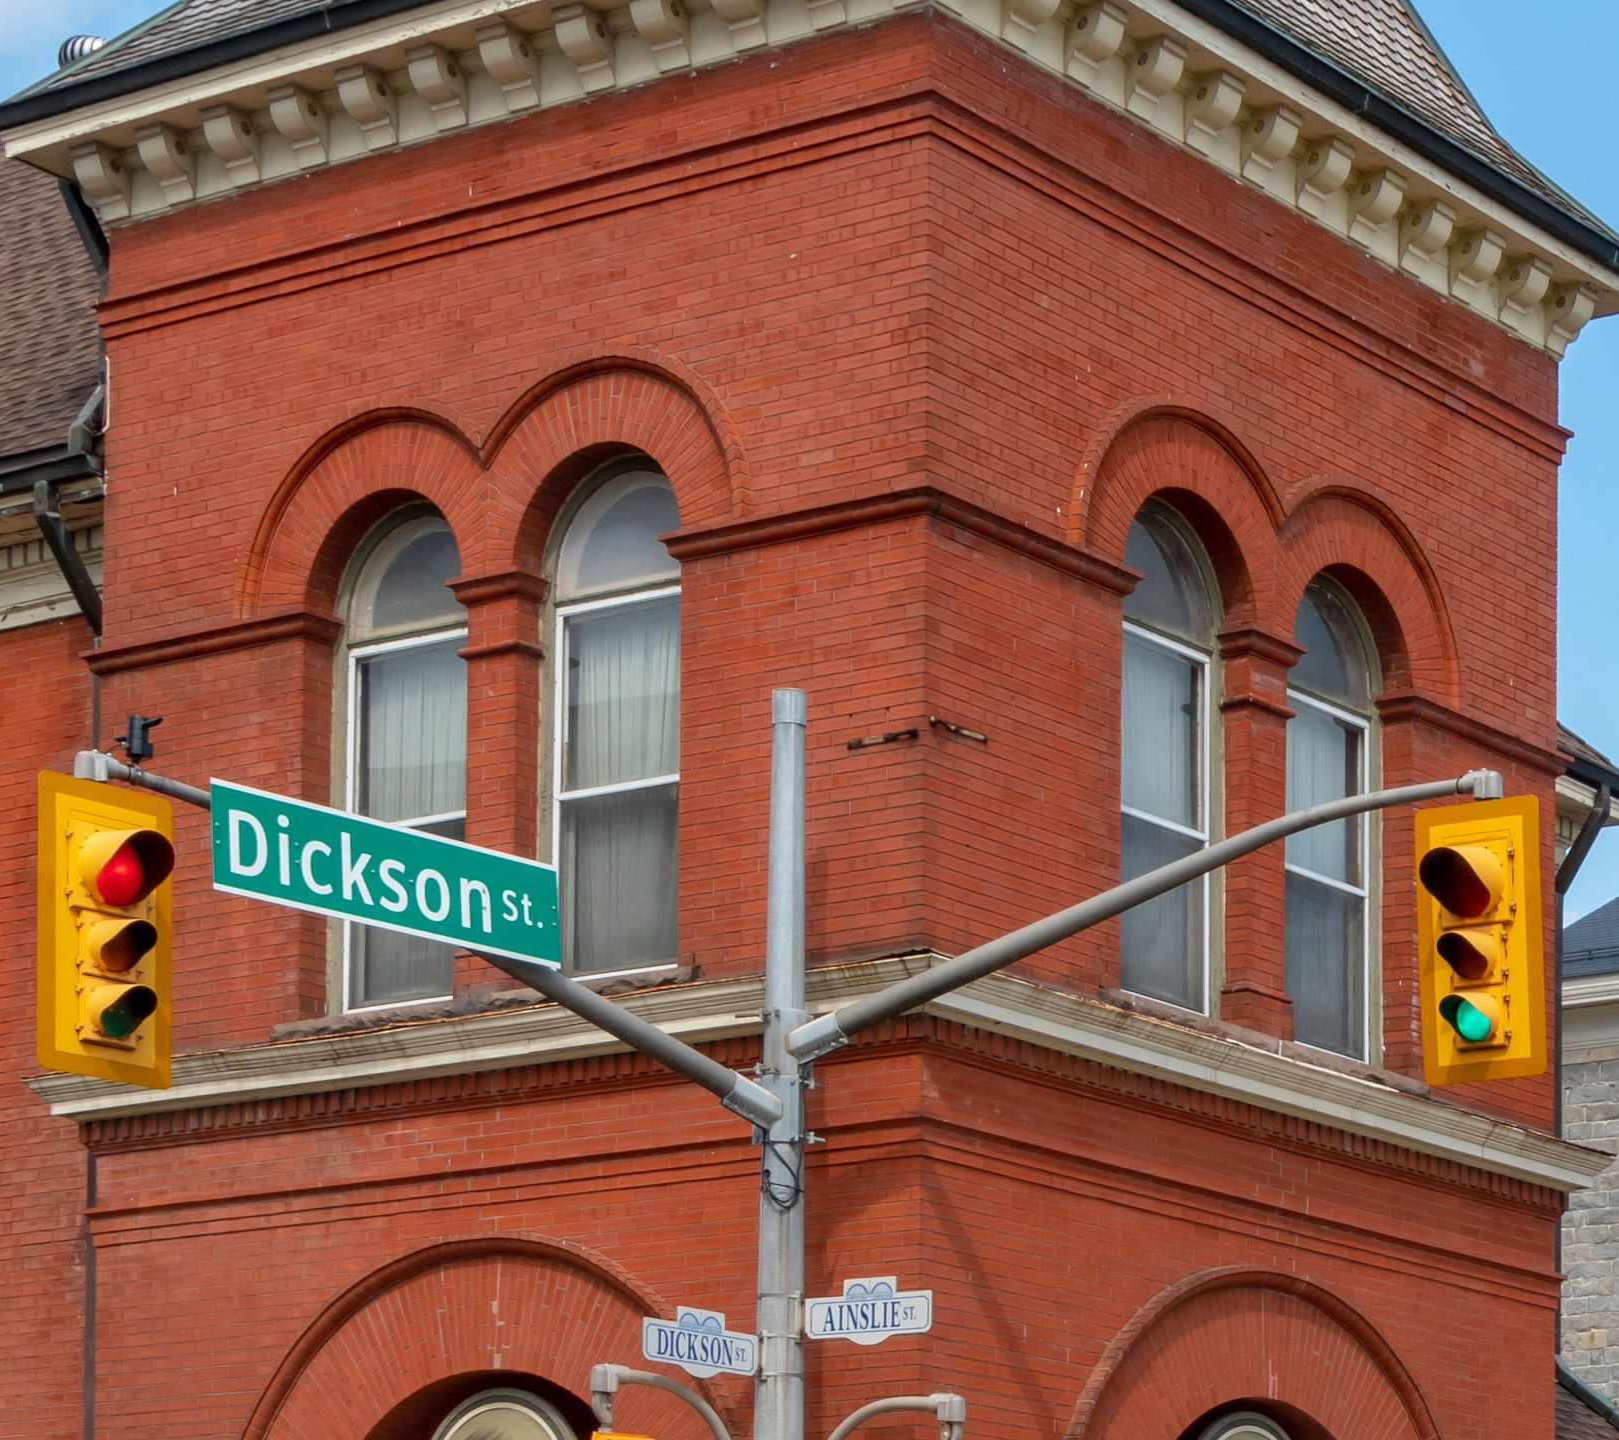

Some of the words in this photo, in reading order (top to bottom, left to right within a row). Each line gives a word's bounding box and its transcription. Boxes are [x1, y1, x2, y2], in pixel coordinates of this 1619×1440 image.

[228, 808, 492, 934] Dickson
[502, 889, 544, 929] St.
[823, 1301, 901, 1332] AINSLIE
[903, 1306, 916, 1320] ST.
[657, 1328, 733, 1366] DICKSON
[735, 1347, 747, 1362] ST.
